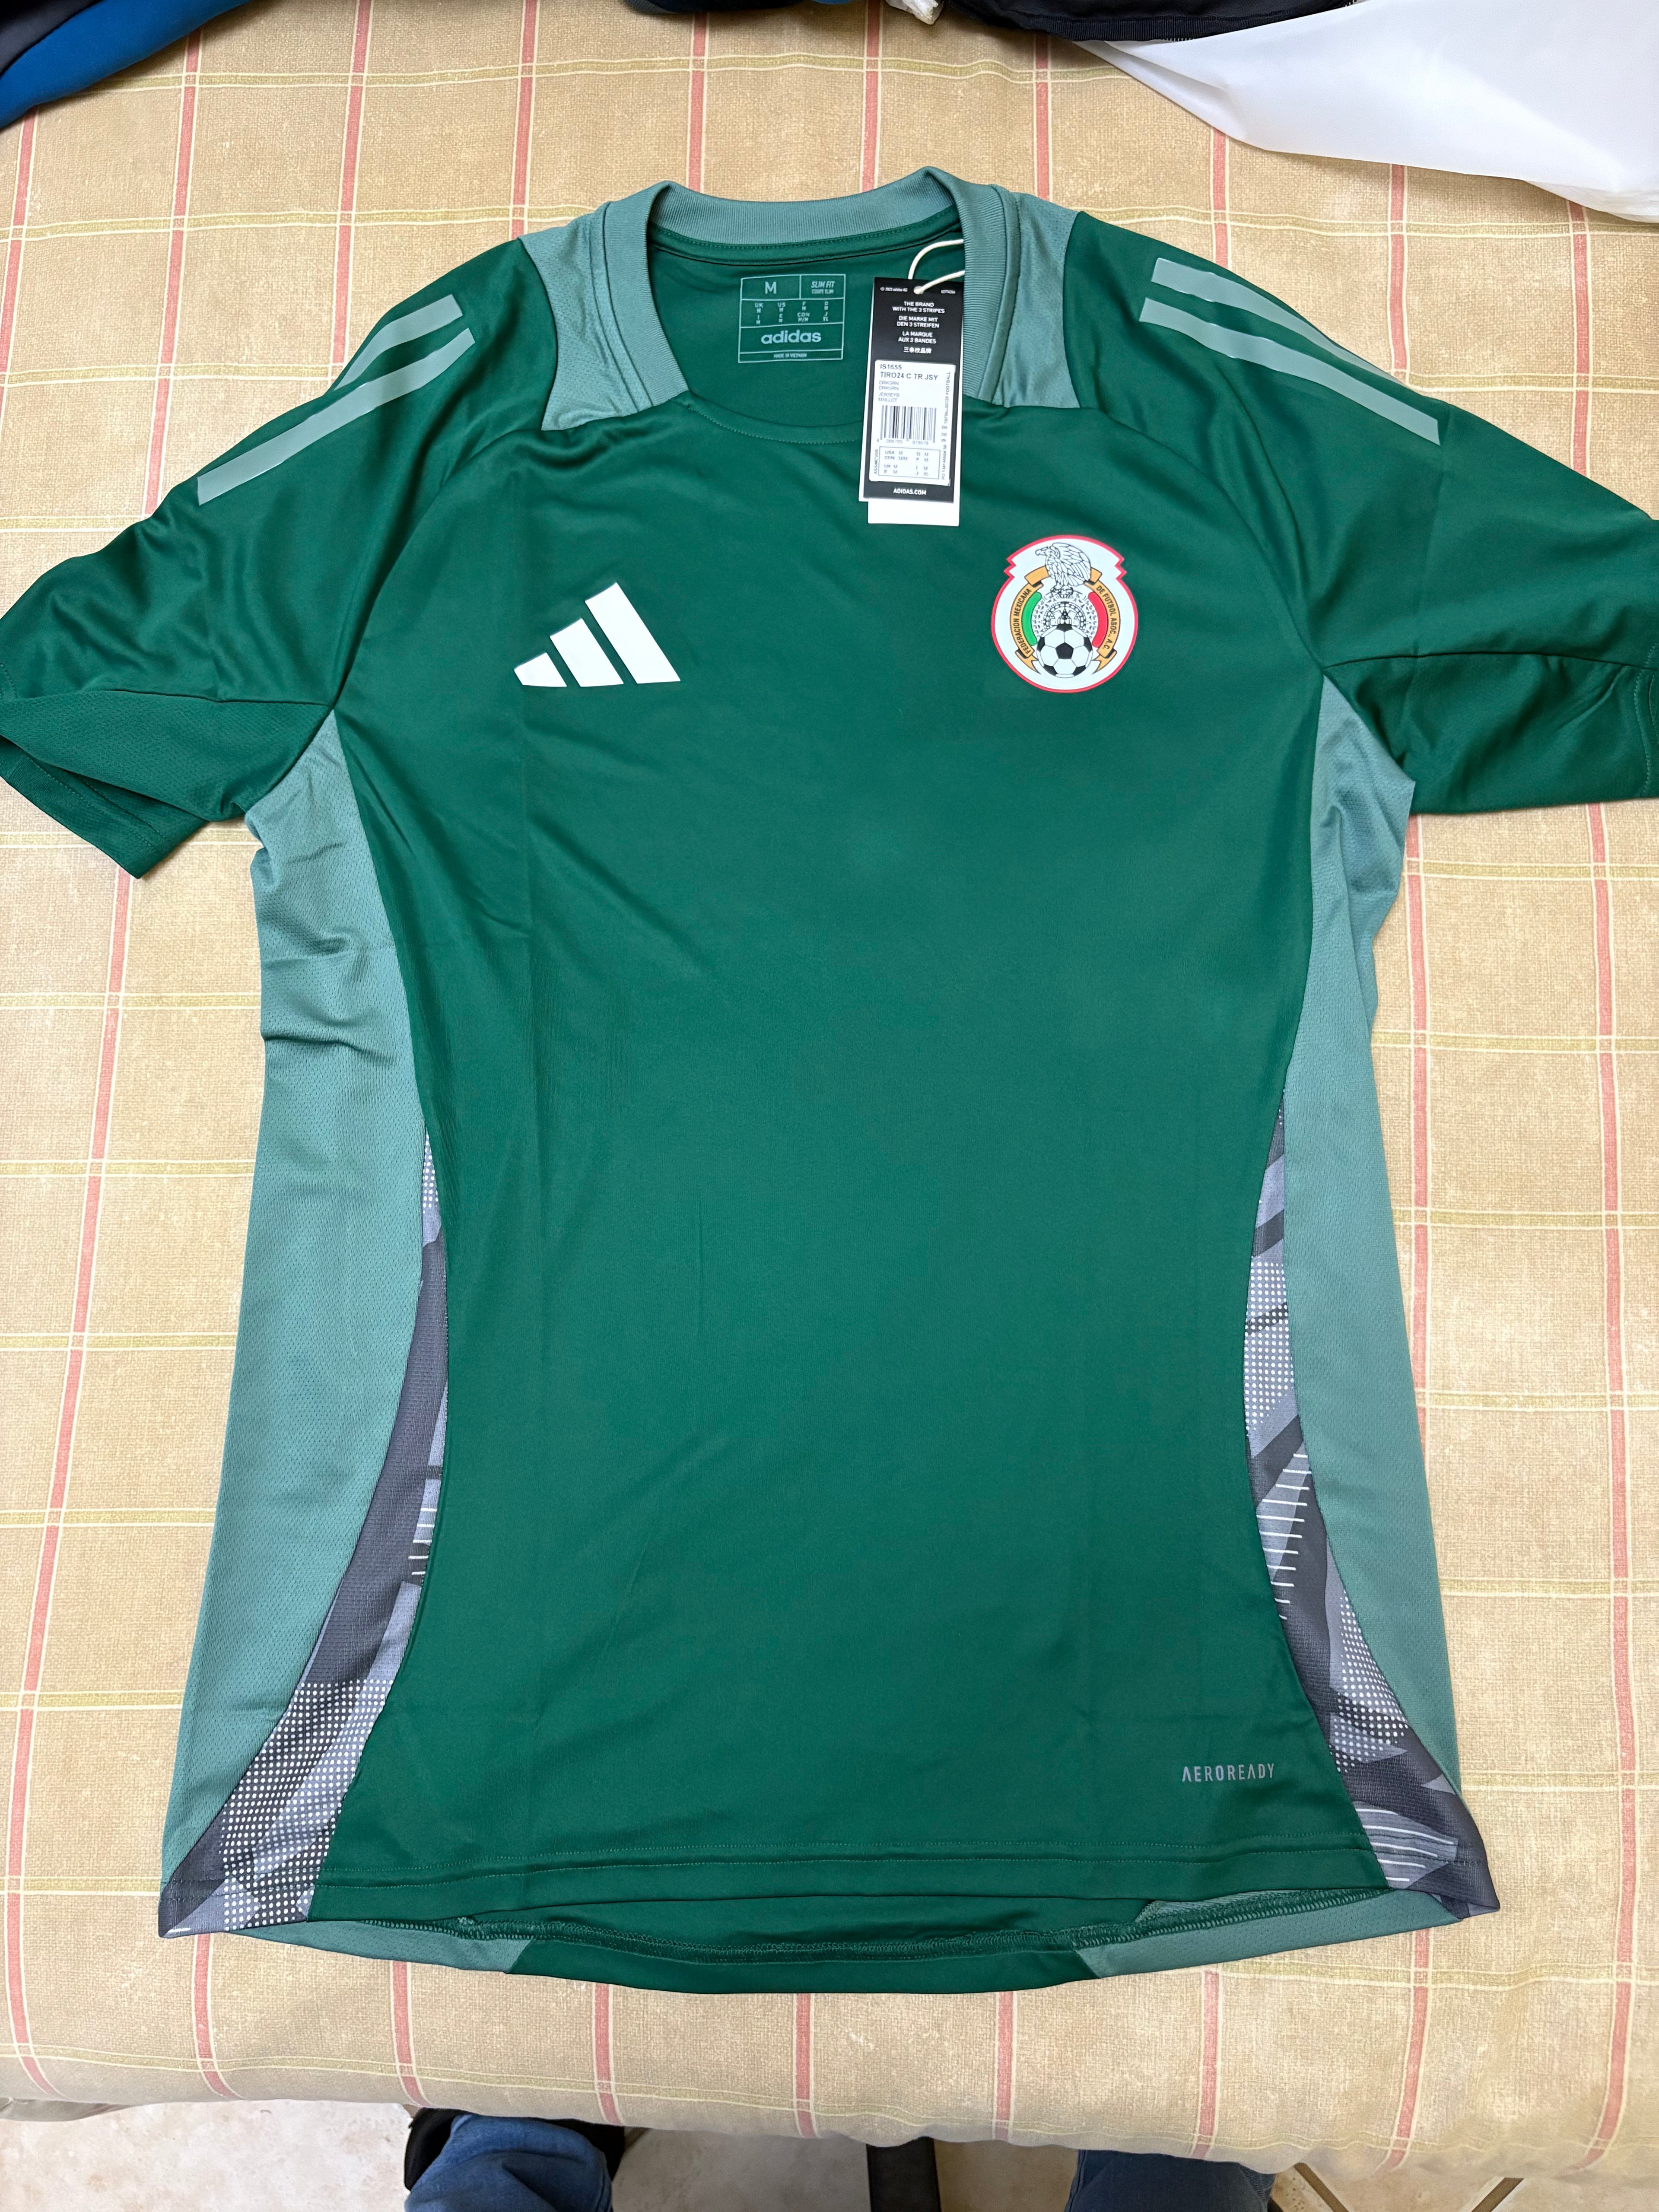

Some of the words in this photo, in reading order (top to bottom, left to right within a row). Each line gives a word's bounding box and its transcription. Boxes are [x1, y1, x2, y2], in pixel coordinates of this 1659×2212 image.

[765, 281, 776, 294] M
[761, 330, 821, 344] adidas
[1096, 585, 1105, 594] DE
[1013, 588, 1032, 617] MEXICANA
[1102, 593, 1116, 616] FUTBOL
[1013, 618, 1031, 654] FEDERACION
[1102, 639, 1113, 650] A.C.
[1182, 1763, 1274, 1782] AEROREADY
